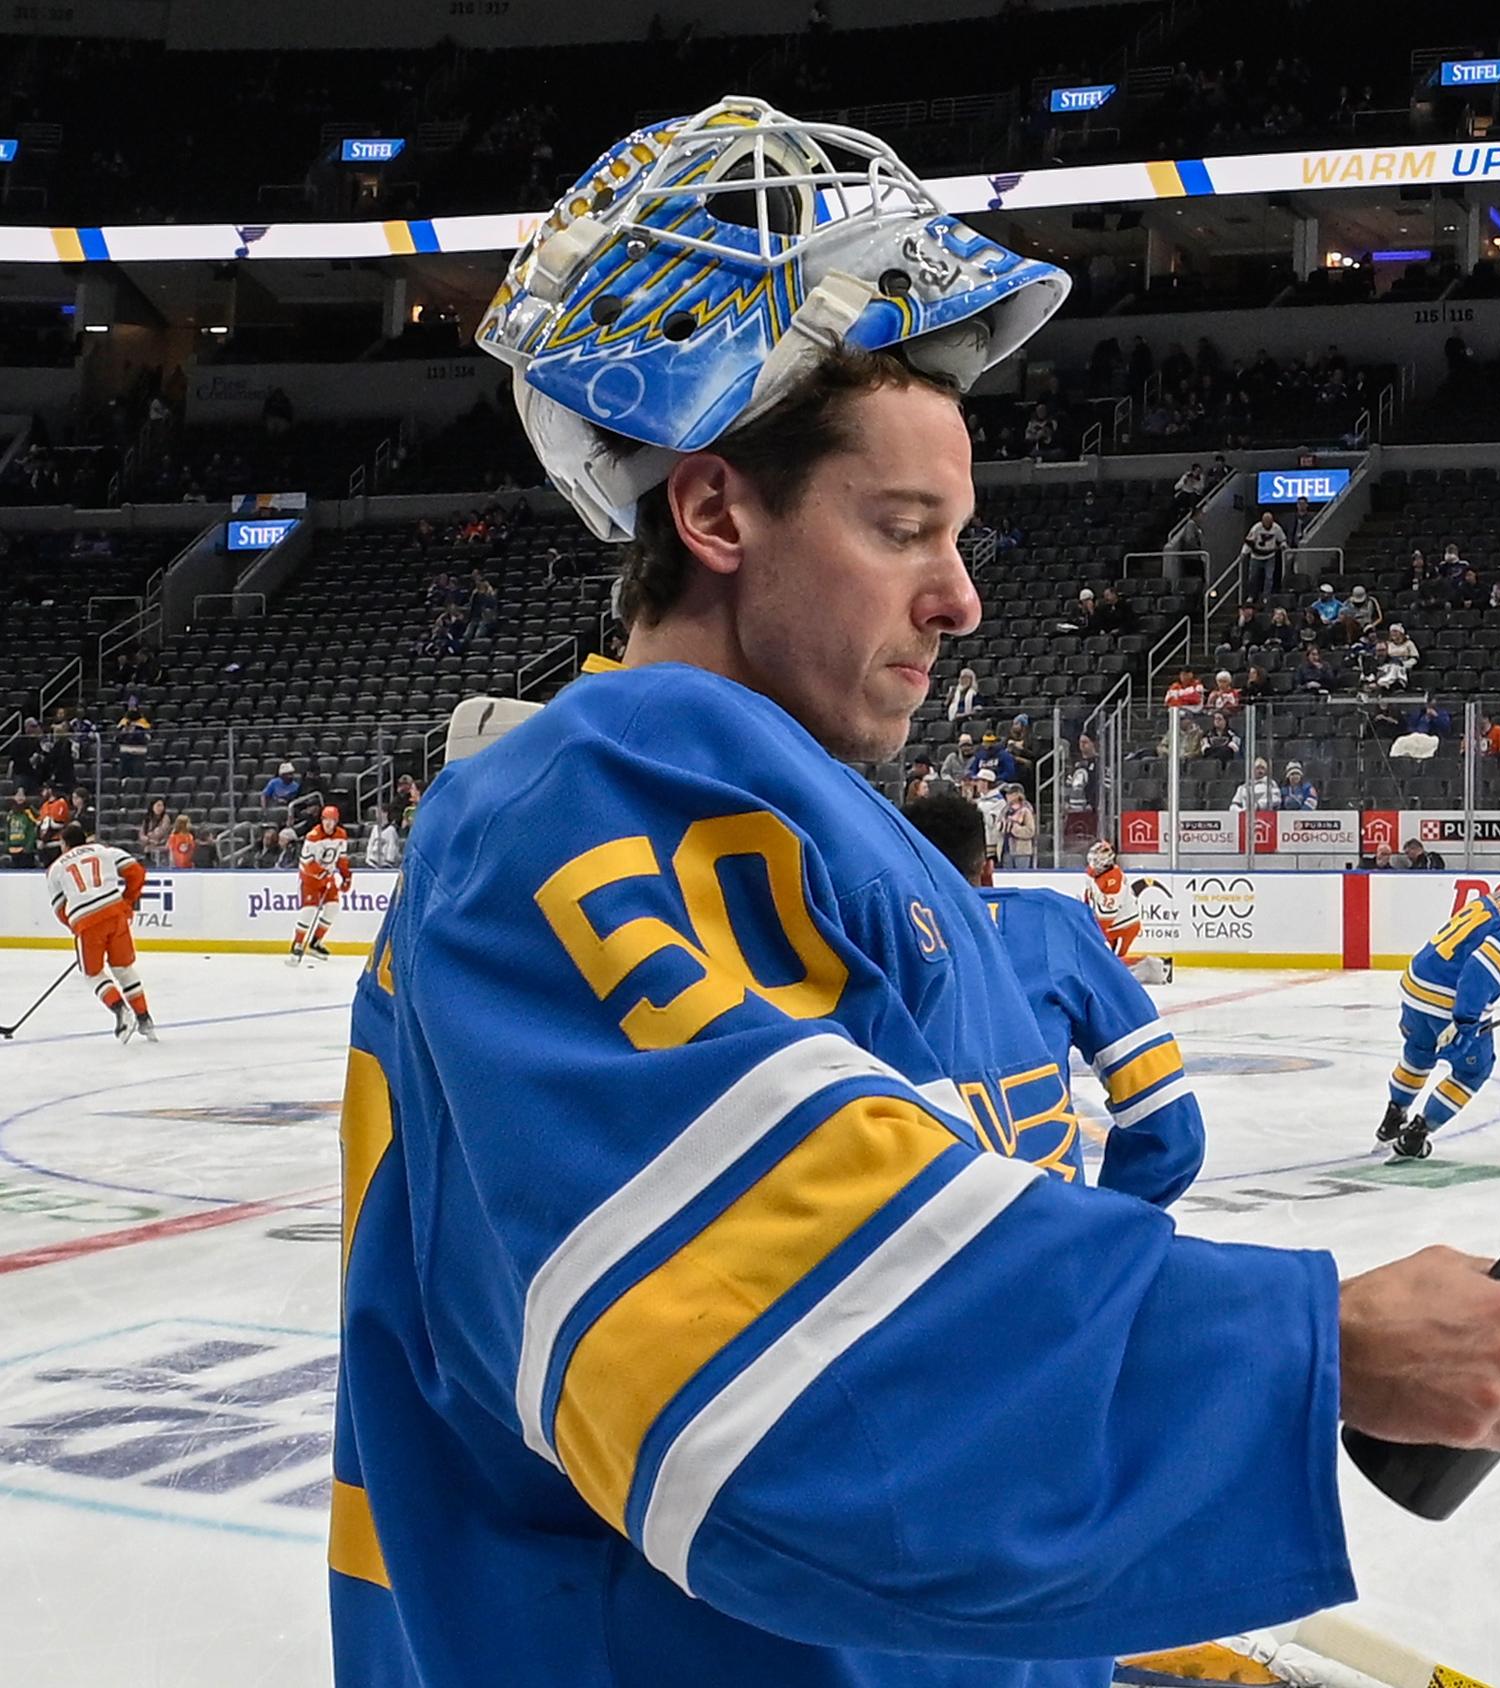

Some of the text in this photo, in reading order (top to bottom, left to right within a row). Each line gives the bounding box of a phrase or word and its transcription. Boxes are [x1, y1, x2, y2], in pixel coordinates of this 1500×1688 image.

[1453, 65, 1499, 81] STIFEL
[1303, 150, 1437, 184] WARM
[1414, 310, 1439, 323] 115
[1450, 308, 1474, 321] 116
[1272, 476, 1336, 499] STIFEL
[1164, 831, 1235, 843] DGHOUSE
[1282, 831, 1354, 844] DOGHOUSE
[66, 856, 103, 893] 17
[249, 887, 389, 918] plan itne
[534, 811, 839, 1050] 50
[1192, 922, 1253, 939] YEARS
[1430, 900, 1493, 961] 81
